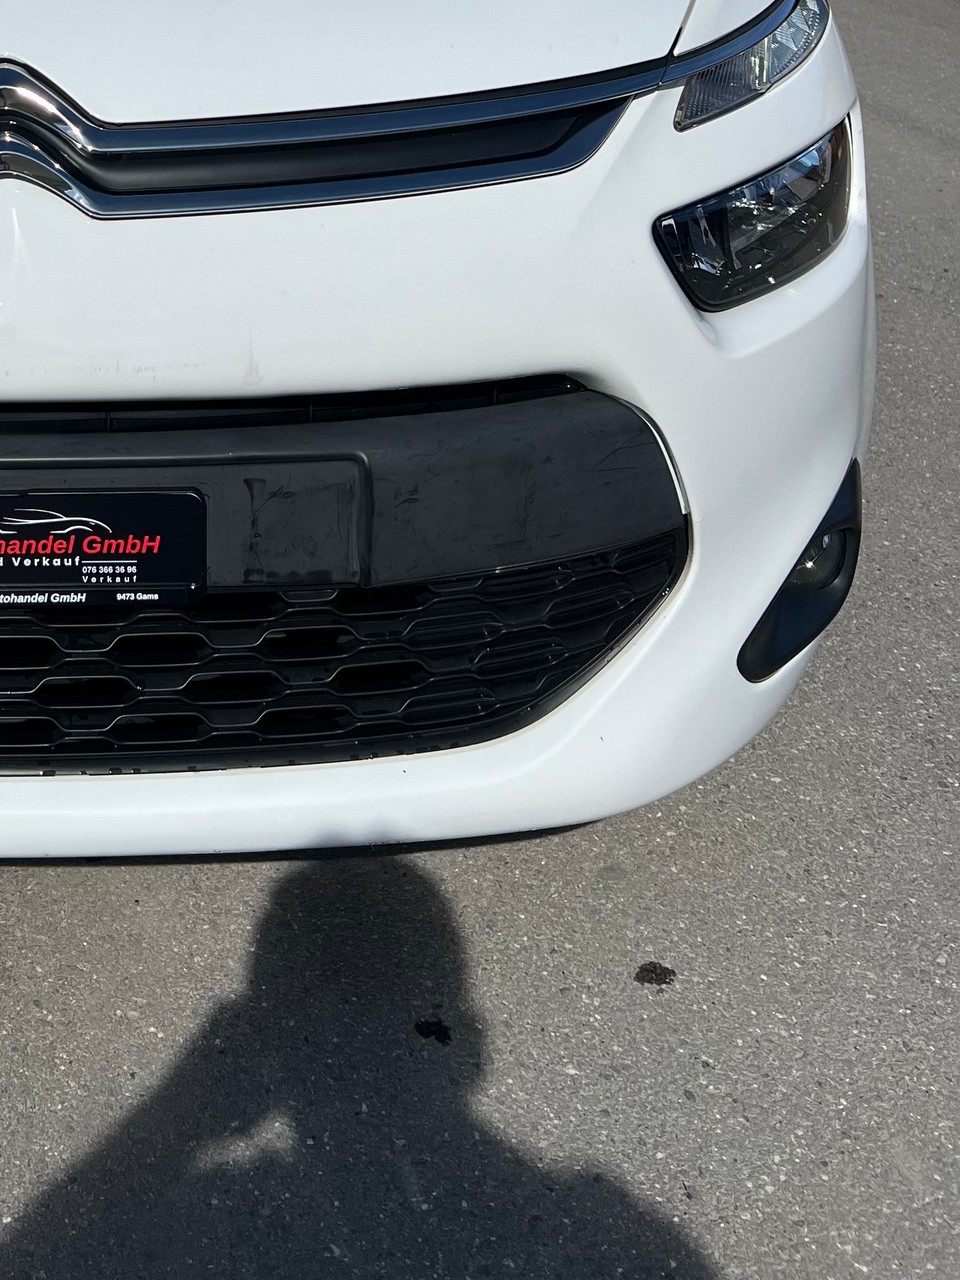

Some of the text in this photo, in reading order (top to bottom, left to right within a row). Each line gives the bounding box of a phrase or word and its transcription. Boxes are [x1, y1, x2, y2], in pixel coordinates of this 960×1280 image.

[82, 534, 161, 554] GmbH
[11, 556, 80, 566] Verkauf
[82, 575, 137, 583] Verkauf
[50, 592, 87, 602] GmbH
[116, 593, 159, 601] 9473 Gams
